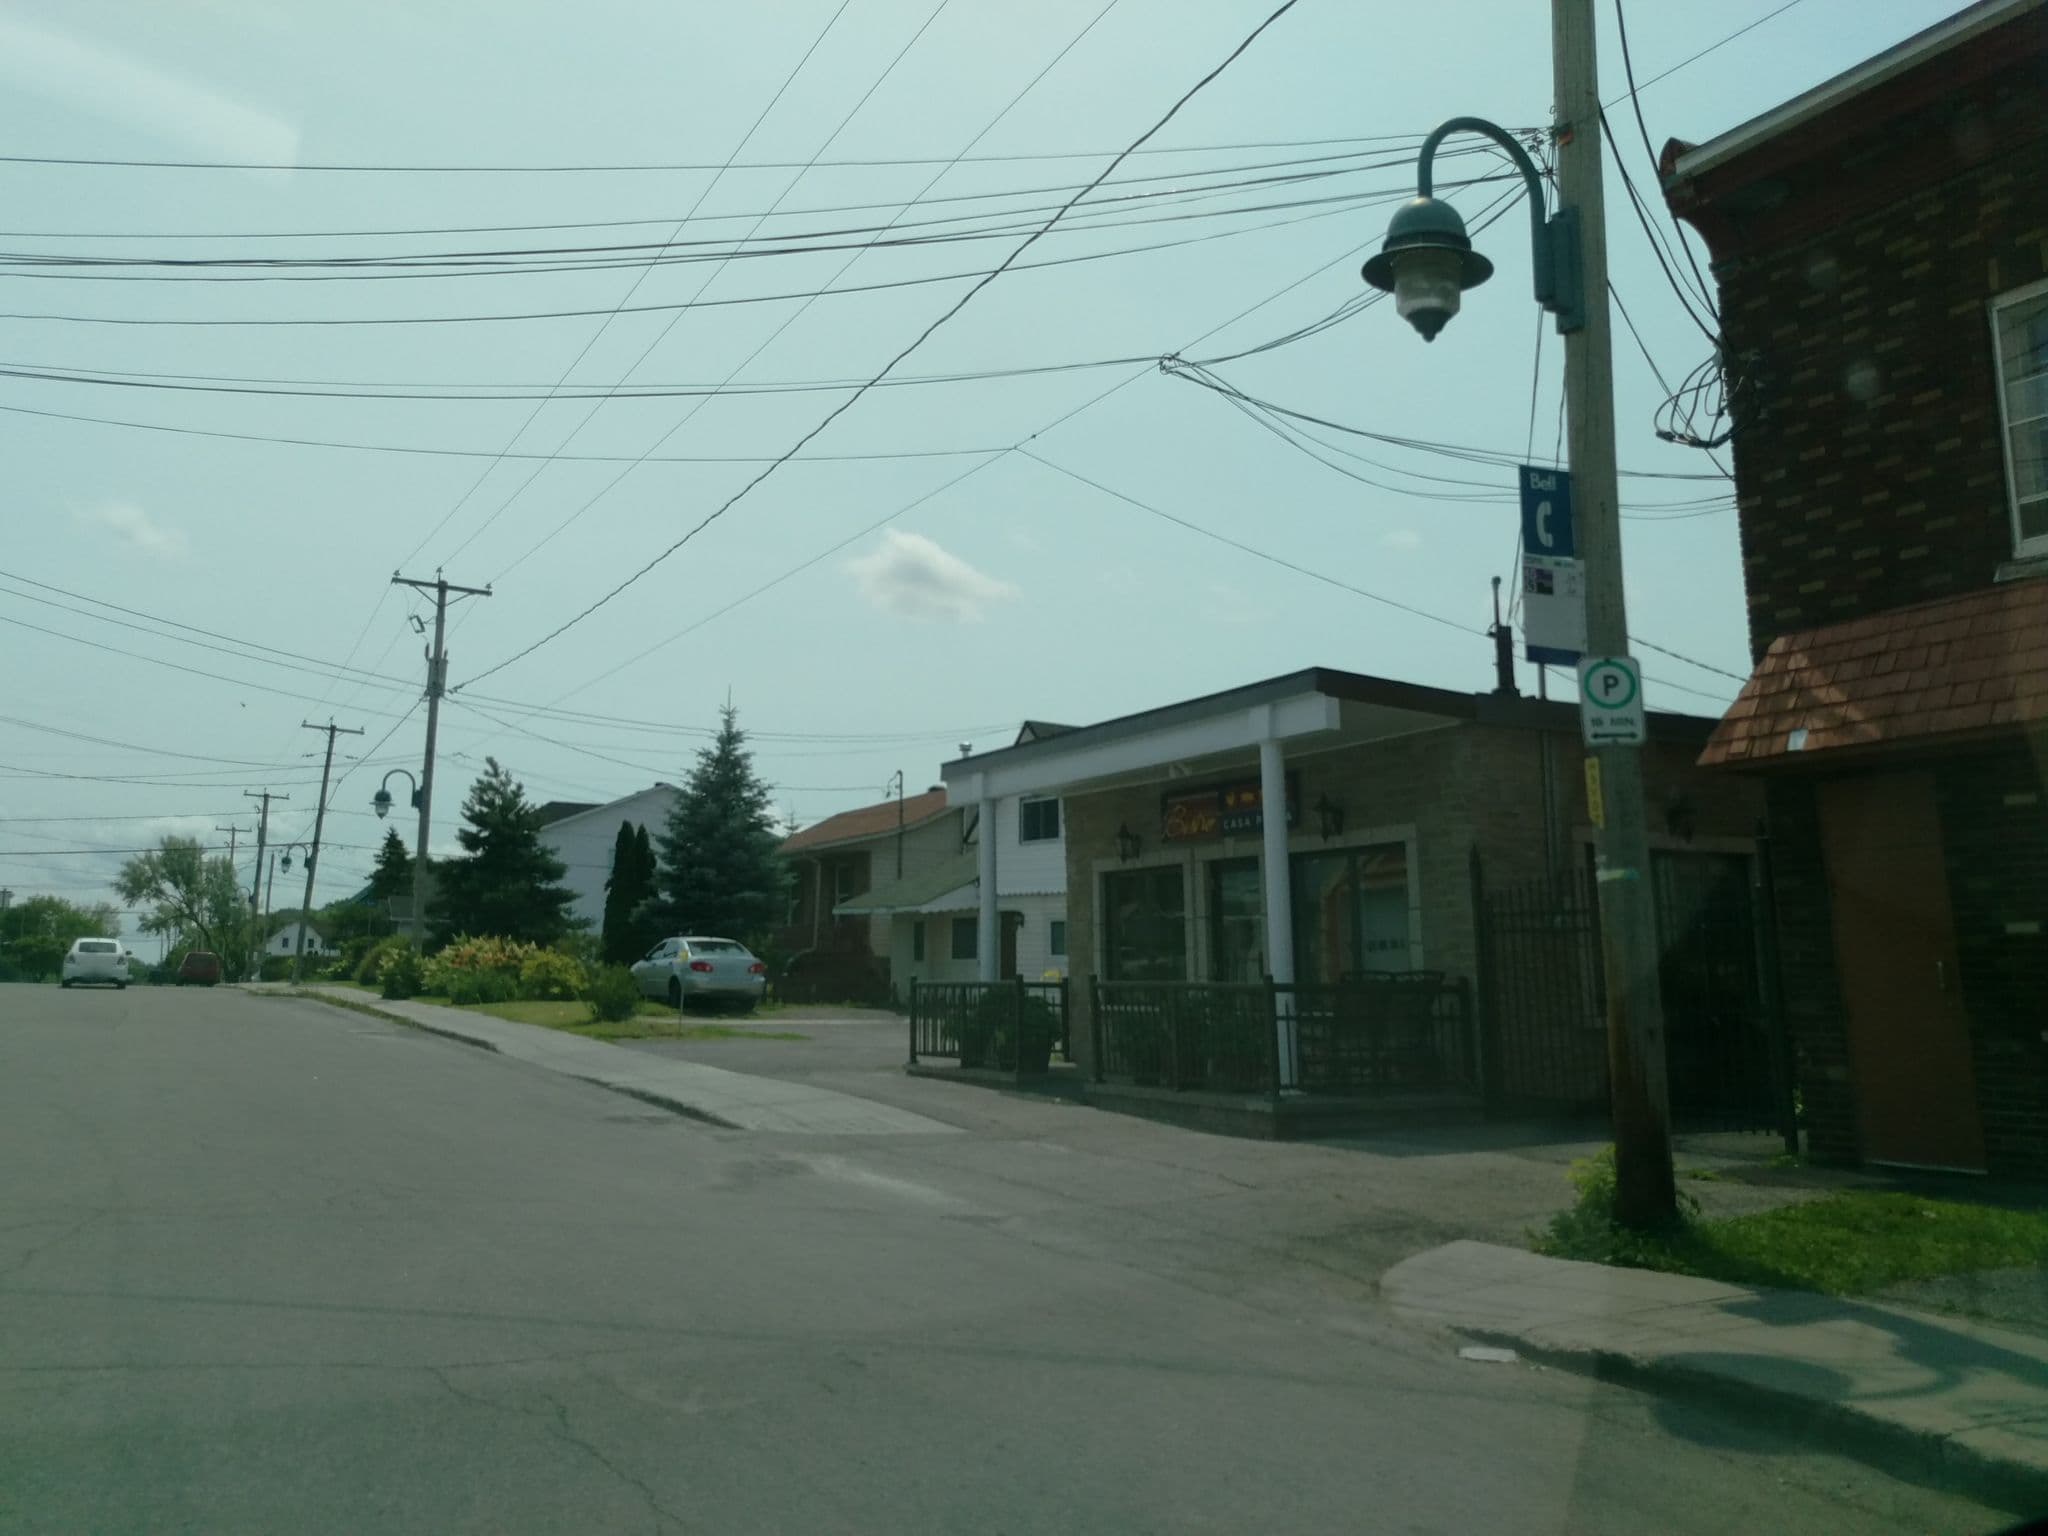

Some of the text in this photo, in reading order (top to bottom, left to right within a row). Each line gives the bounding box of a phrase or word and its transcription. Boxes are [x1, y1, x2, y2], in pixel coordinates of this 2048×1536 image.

[1530, 469, 1556, 490] Bell
[1603, 674, 1619, 696] P
[1224, 817, 1251, 830] CASA
